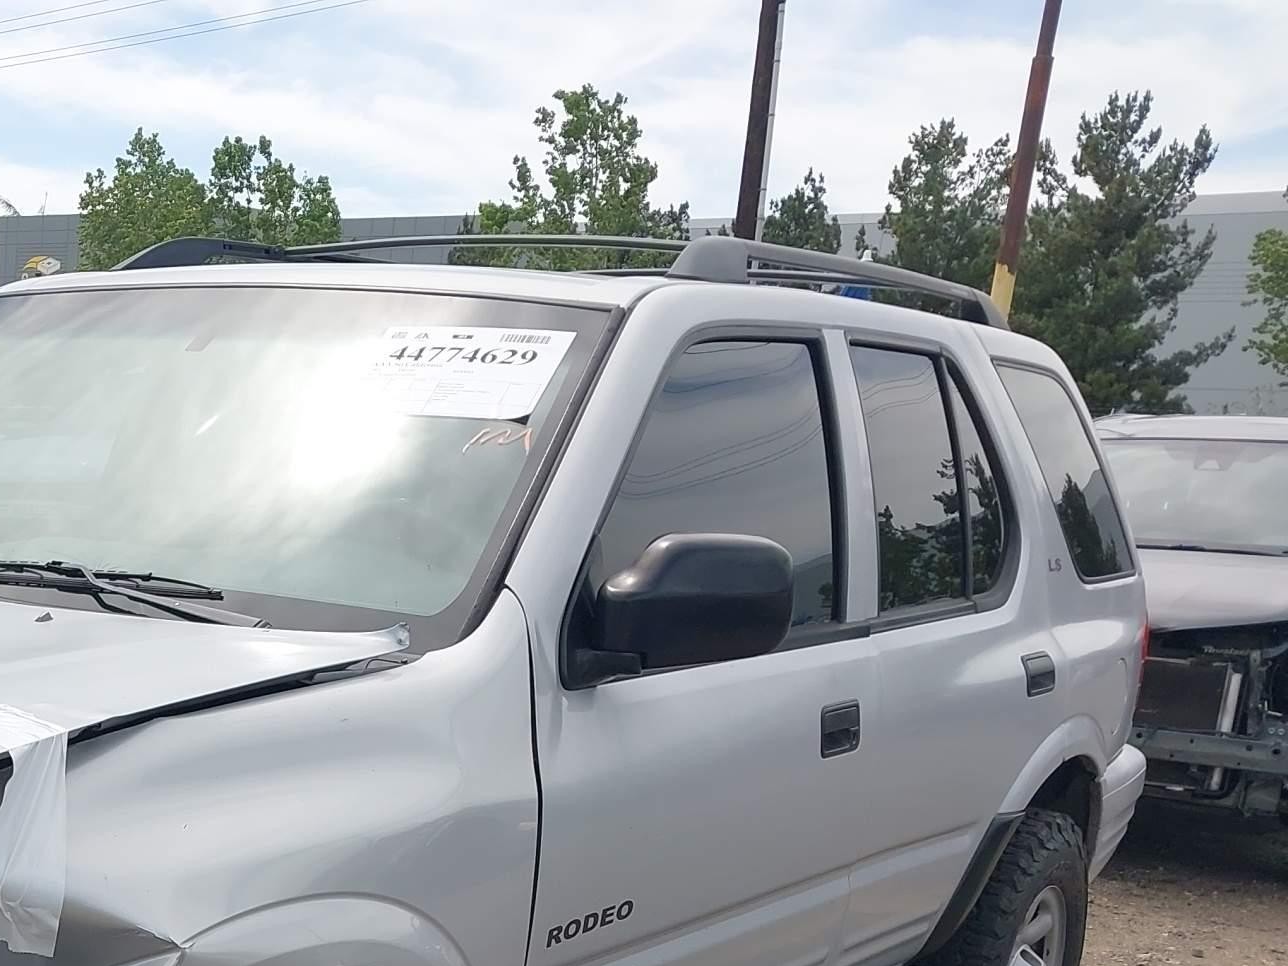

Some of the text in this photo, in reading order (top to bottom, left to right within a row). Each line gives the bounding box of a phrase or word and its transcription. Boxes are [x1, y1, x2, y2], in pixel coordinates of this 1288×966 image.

[389, 346, 539, 366] 44774629
[1047, 557, 1063, 573] LS
[545, 899, 635, 949] RODEO
